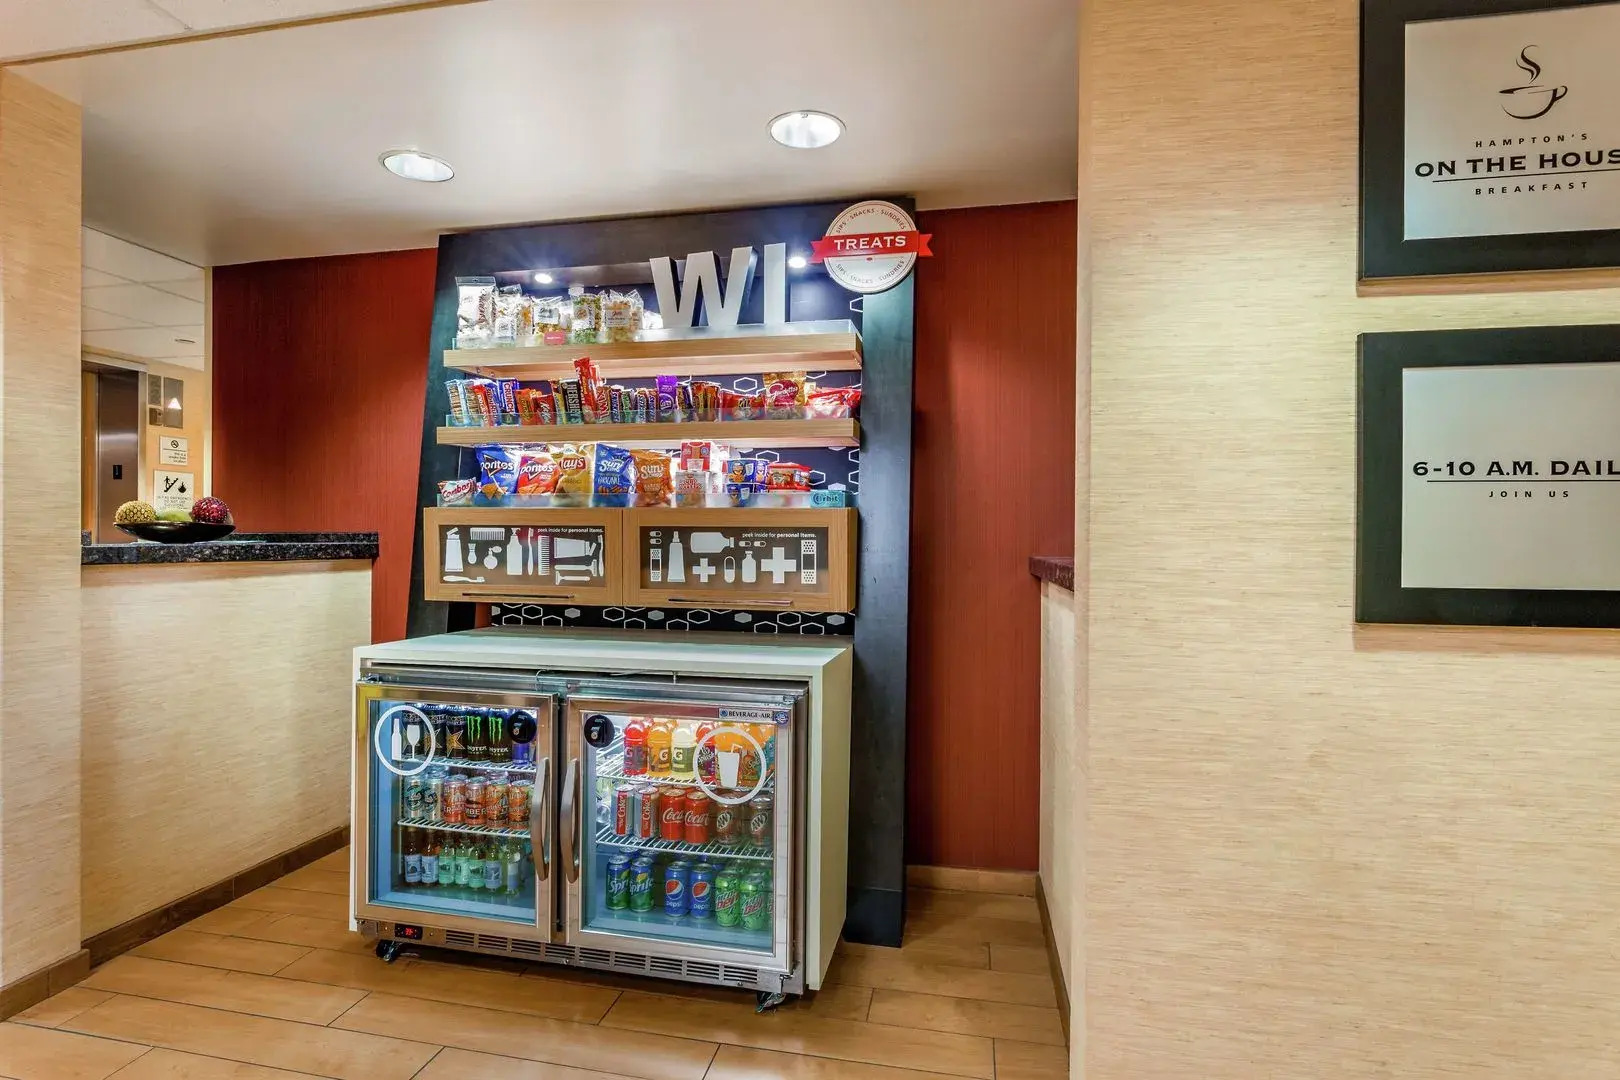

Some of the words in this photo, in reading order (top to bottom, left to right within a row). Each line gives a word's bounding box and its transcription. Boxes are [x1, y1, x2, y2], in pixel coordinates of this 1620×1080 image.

[1475, 132, 1588, 148] HAMPTON'S
[1414, 160, 1456, 178] ON
[1466, 155, 1527, 174] THE
[1539, 149, 1620, 169] HOUS
[1475, 181, 1589, 196] BREAKFAST
[849, 208, 875, 220] SNACKS
[880, 209, 906, 230] SUNDRIES
[833, 235, 907, 251] TREATS
[878, 260, 906, 281] SUNDRIES
[503, 382, 515, 413] CRUNCH
[567, 383, 583, 424] HERSHEY'S
[1412, 461, 1476, 477] 6-10
[1486, 460, 1540, 476] A.M.
[1550, 460, 1620, 476] DAIL
[442, 481, 472, 499] Combos
[1488, 490, 1533, 499] JOIN
[1548, 490, 1570, 499] US
[728, 710, 772, 719] BEVERAGE-AIR
[617, 795, 627, 818] Coke
[642, 799, 652, 821] Coke
